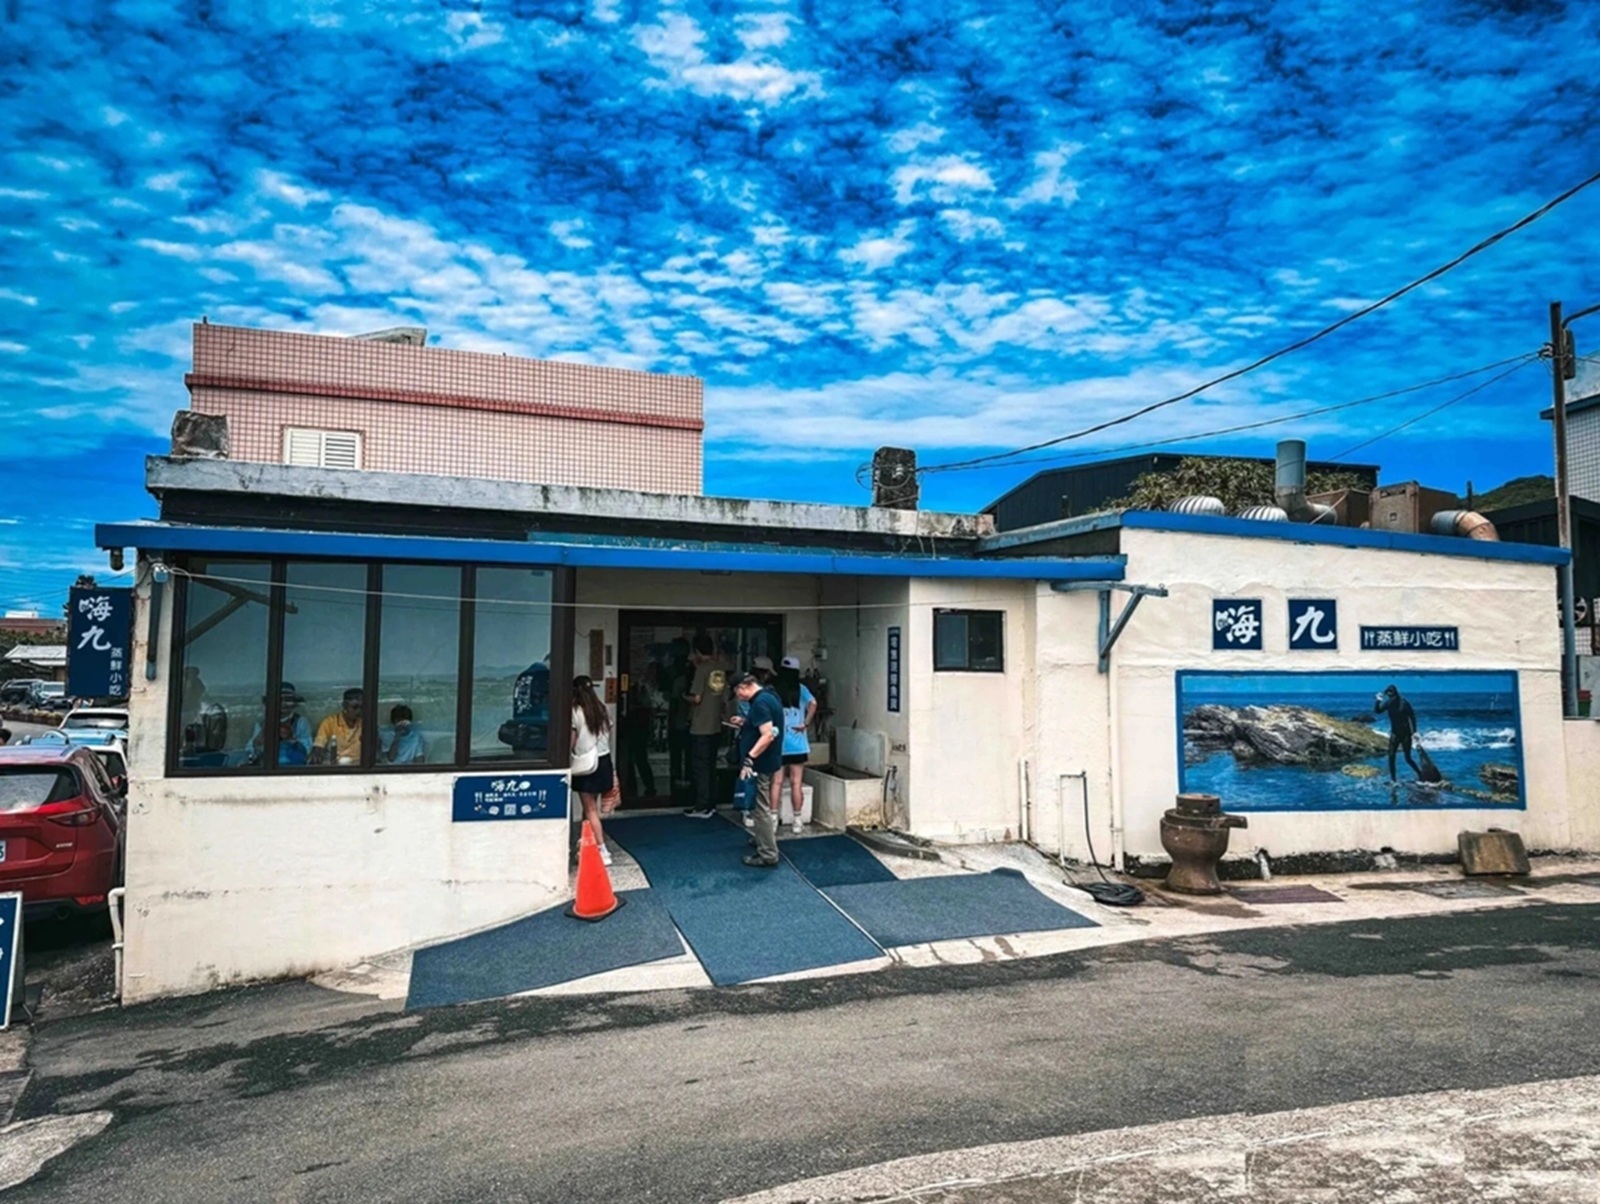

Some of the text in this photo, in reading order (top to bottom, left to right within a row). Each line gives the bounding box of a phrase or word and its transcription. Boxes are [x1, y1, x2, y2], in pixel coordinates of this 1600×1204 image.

[1376, 629, 1443, 647] 蒸鮮小吃
[109, 648, 123, 696] 蒸鮮小吃
